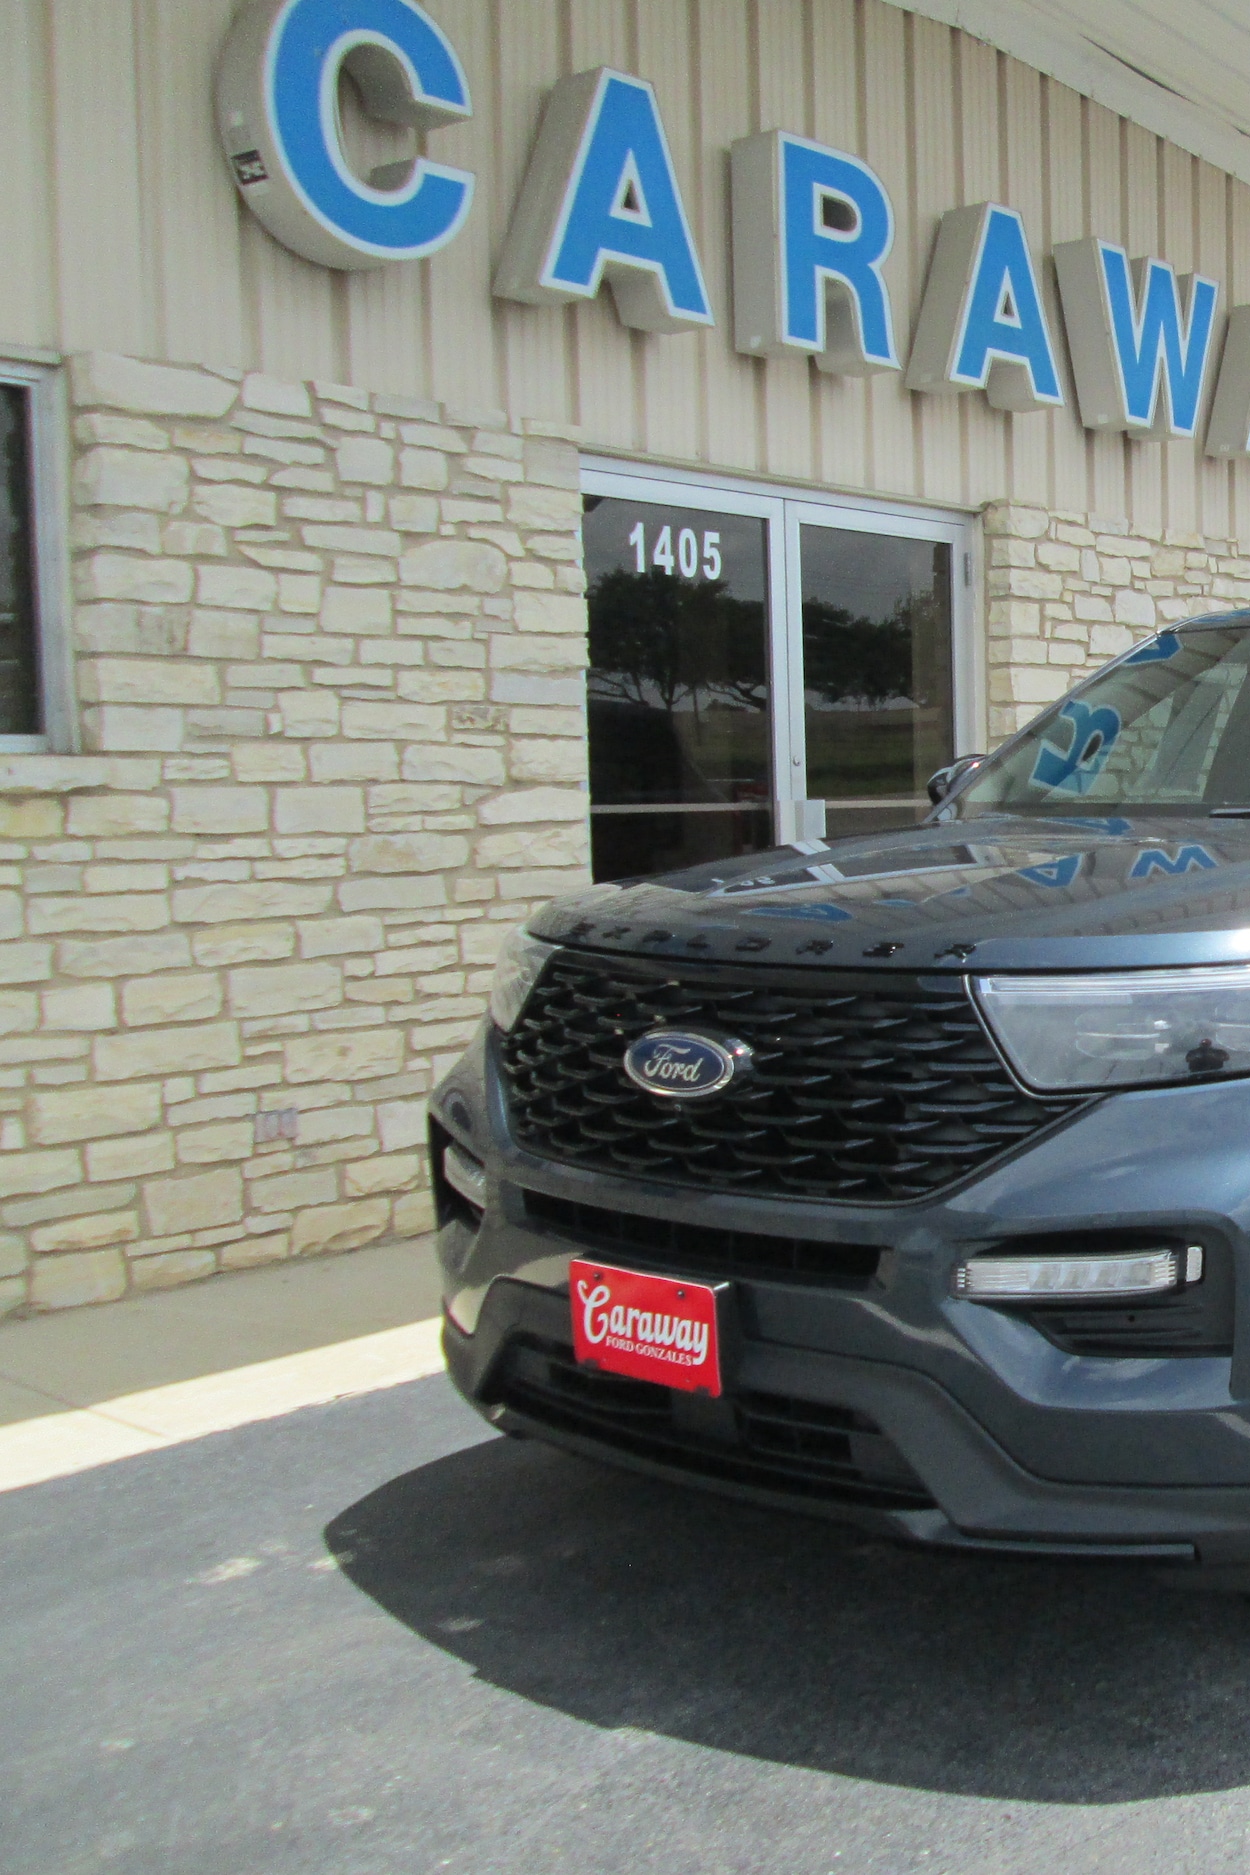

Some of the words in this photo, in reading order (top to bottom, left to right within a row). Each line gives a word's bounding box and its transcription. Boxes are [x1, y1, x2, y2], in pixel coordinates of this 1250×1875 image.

[629, 521, 722, 580] 1405
[644, 1043, 703, 1082] Ford
[577, 1280, 709, 1366] Caraway
